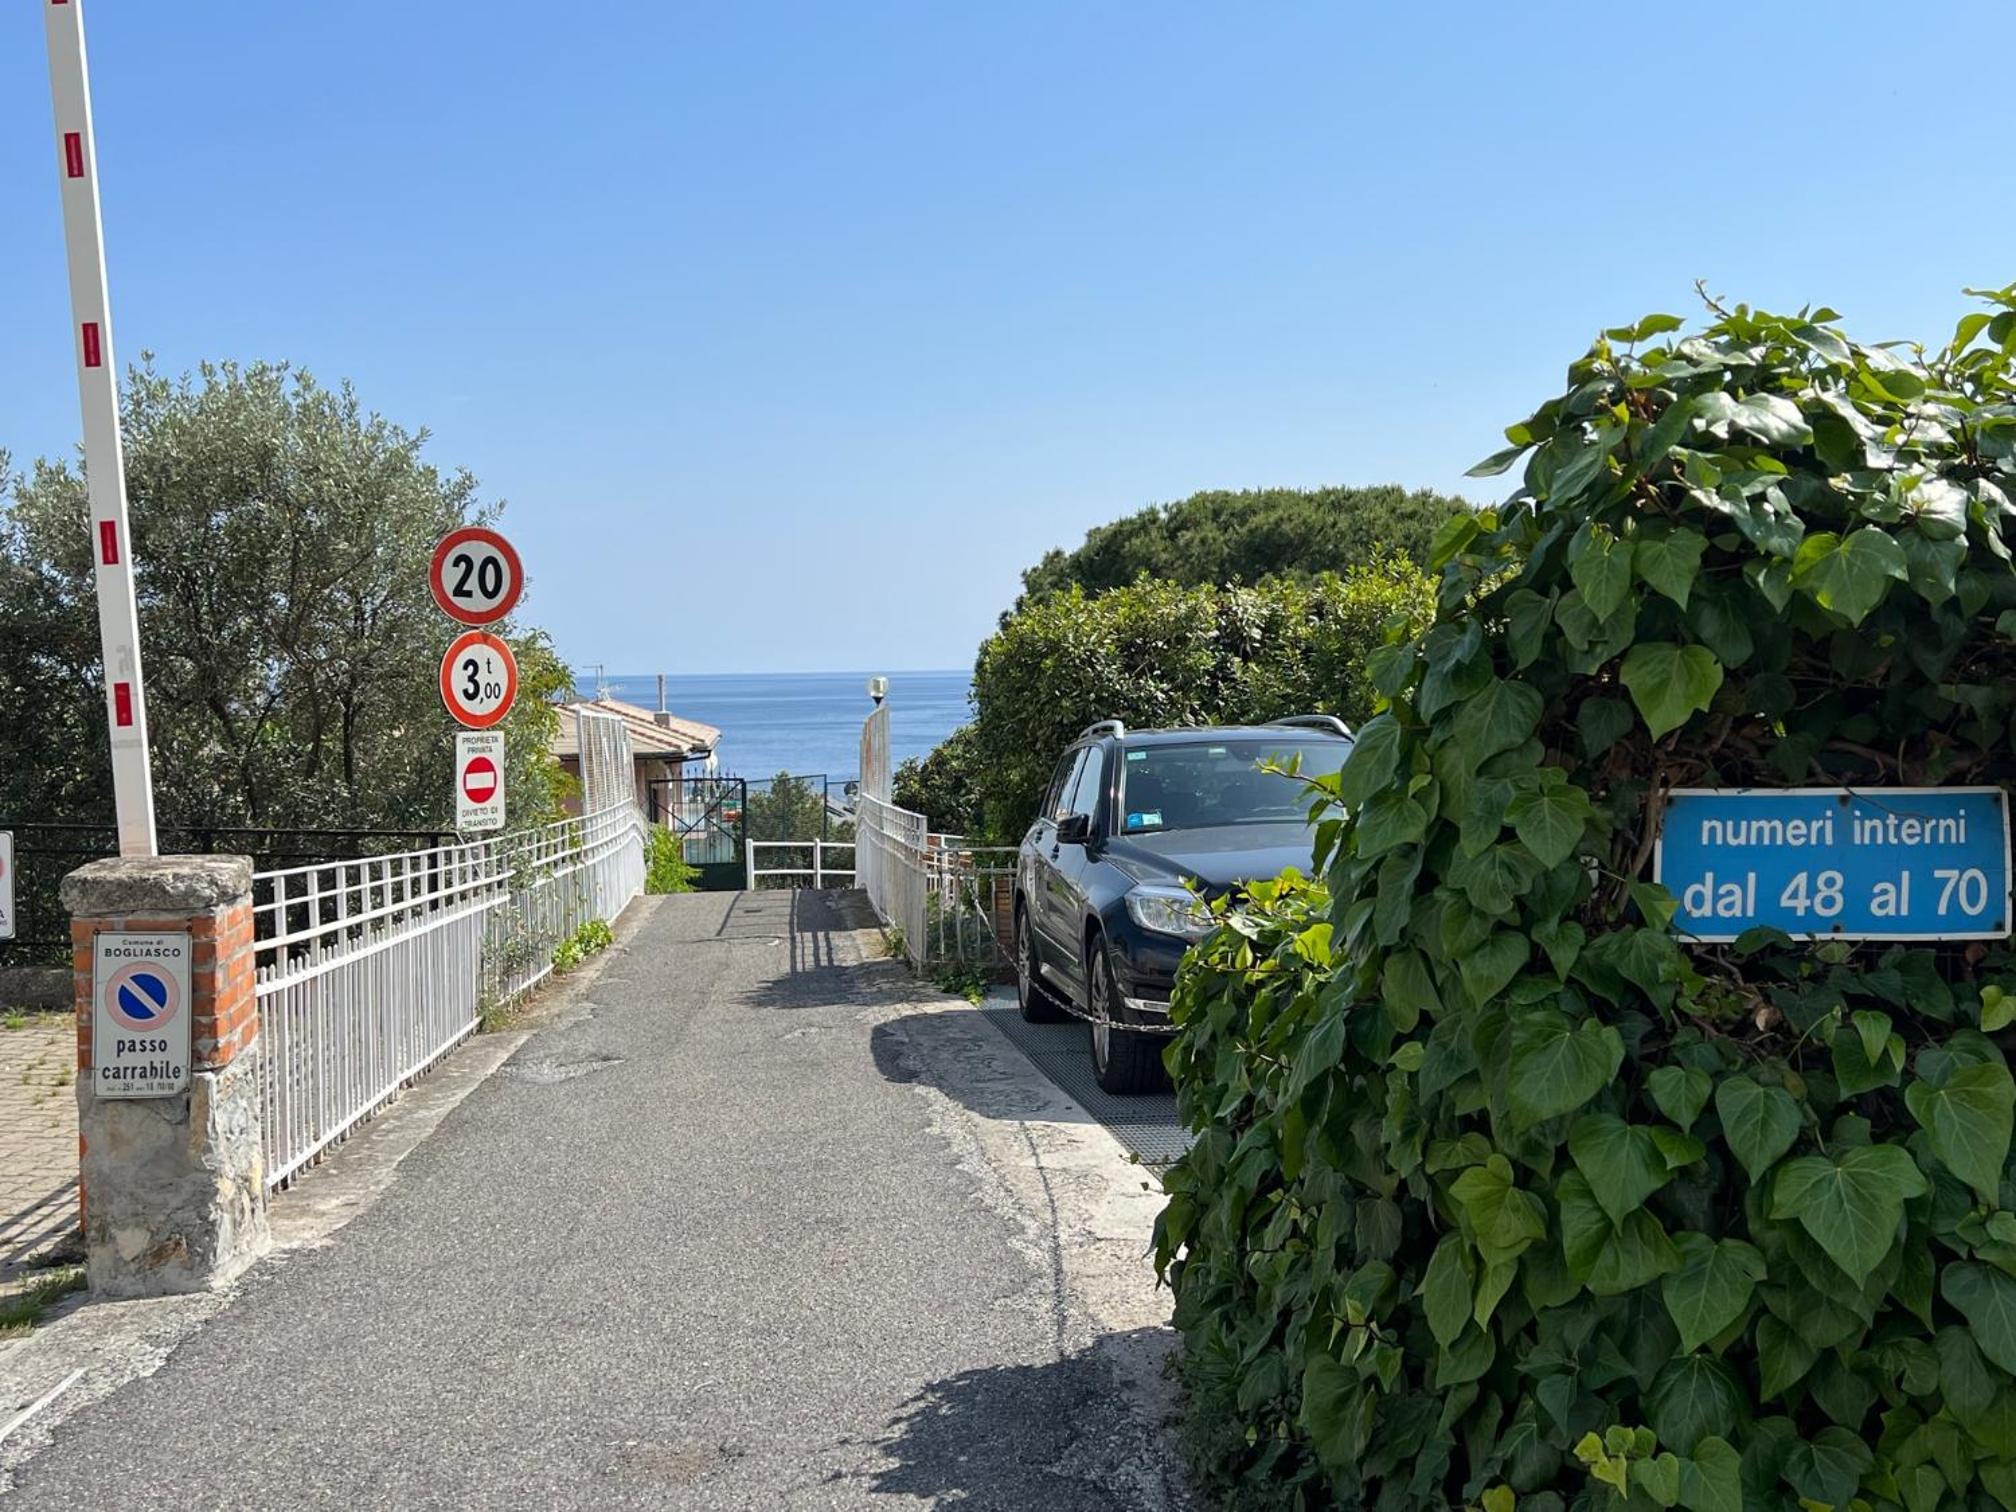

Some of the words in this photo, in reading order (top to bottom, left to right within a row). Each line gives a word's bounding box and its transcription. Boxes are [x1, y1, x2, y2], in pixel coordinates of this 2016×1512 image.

[452, 554, 502, 599] 20
[1701, 810, 1833, 846] numeri
[1853, 809, 1966, 845] interni
[1683, 872, 1756, 918] dal
[1780, 870, 1844, 917] 48
[1870, 870, 1909, 916] al
[1934, 868, 1988, 916] 70
[104, 948, 181, 957] BOGLIASCO
[116, 1039, 167, 1058] passo
[102, 1060, 181, 1079] carrabile
